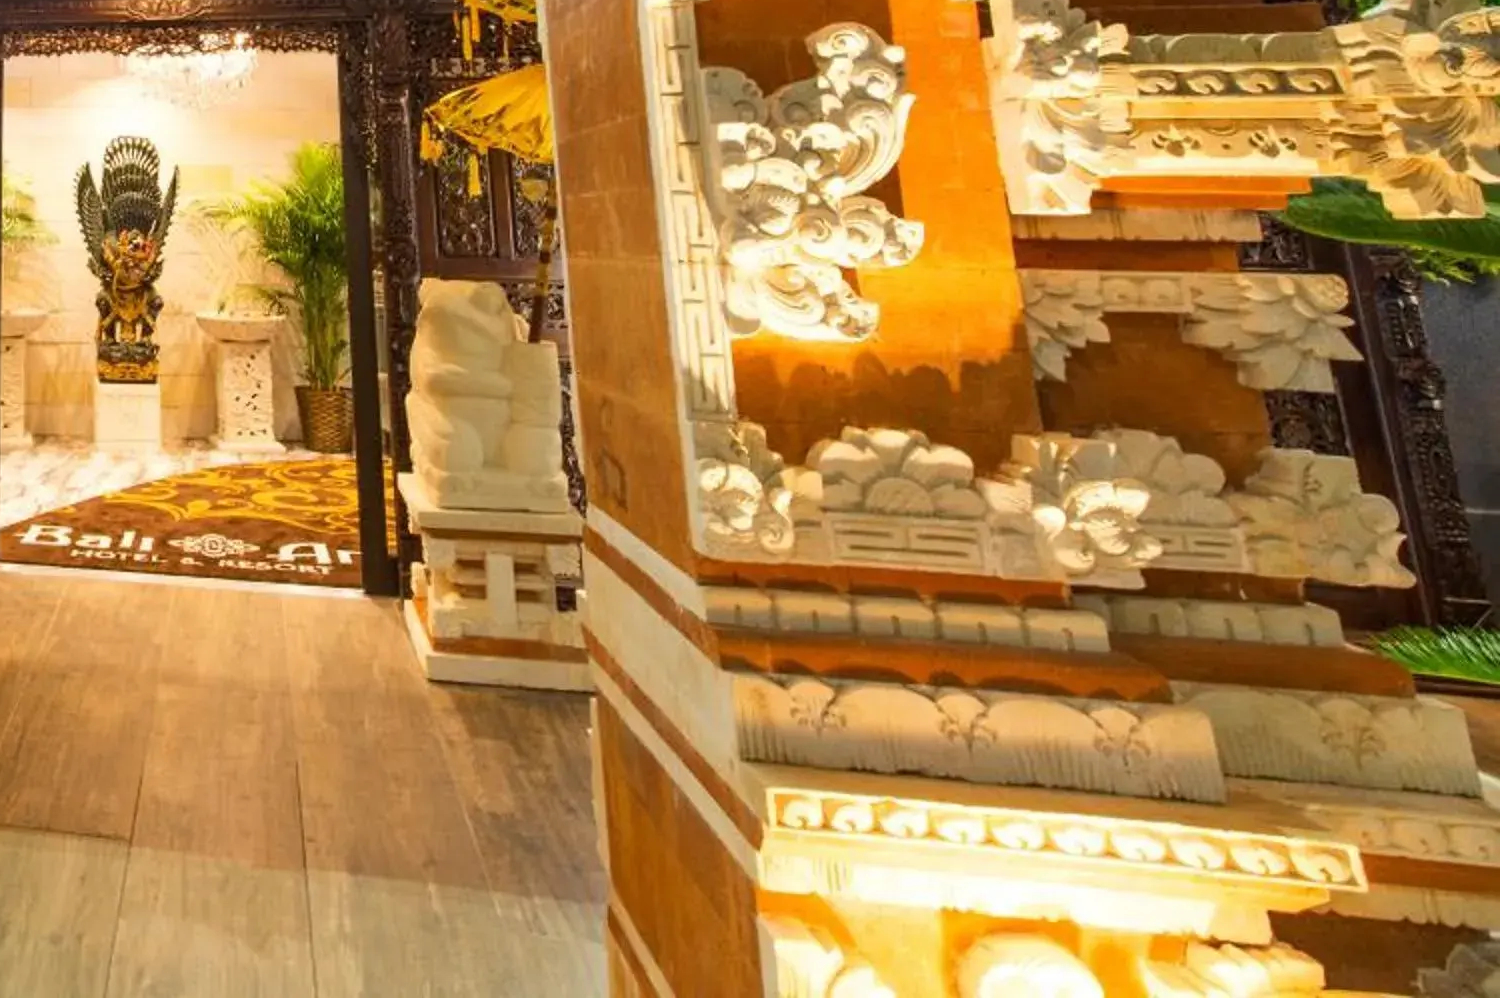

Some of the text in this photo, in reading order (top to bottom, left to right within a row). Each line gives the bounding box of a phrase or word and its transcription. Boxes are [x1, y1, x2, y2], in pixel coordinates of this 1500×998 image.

[12, 524, 155, 552] Bali
[70, 549, 335, 575] HOTEL & RESORT
